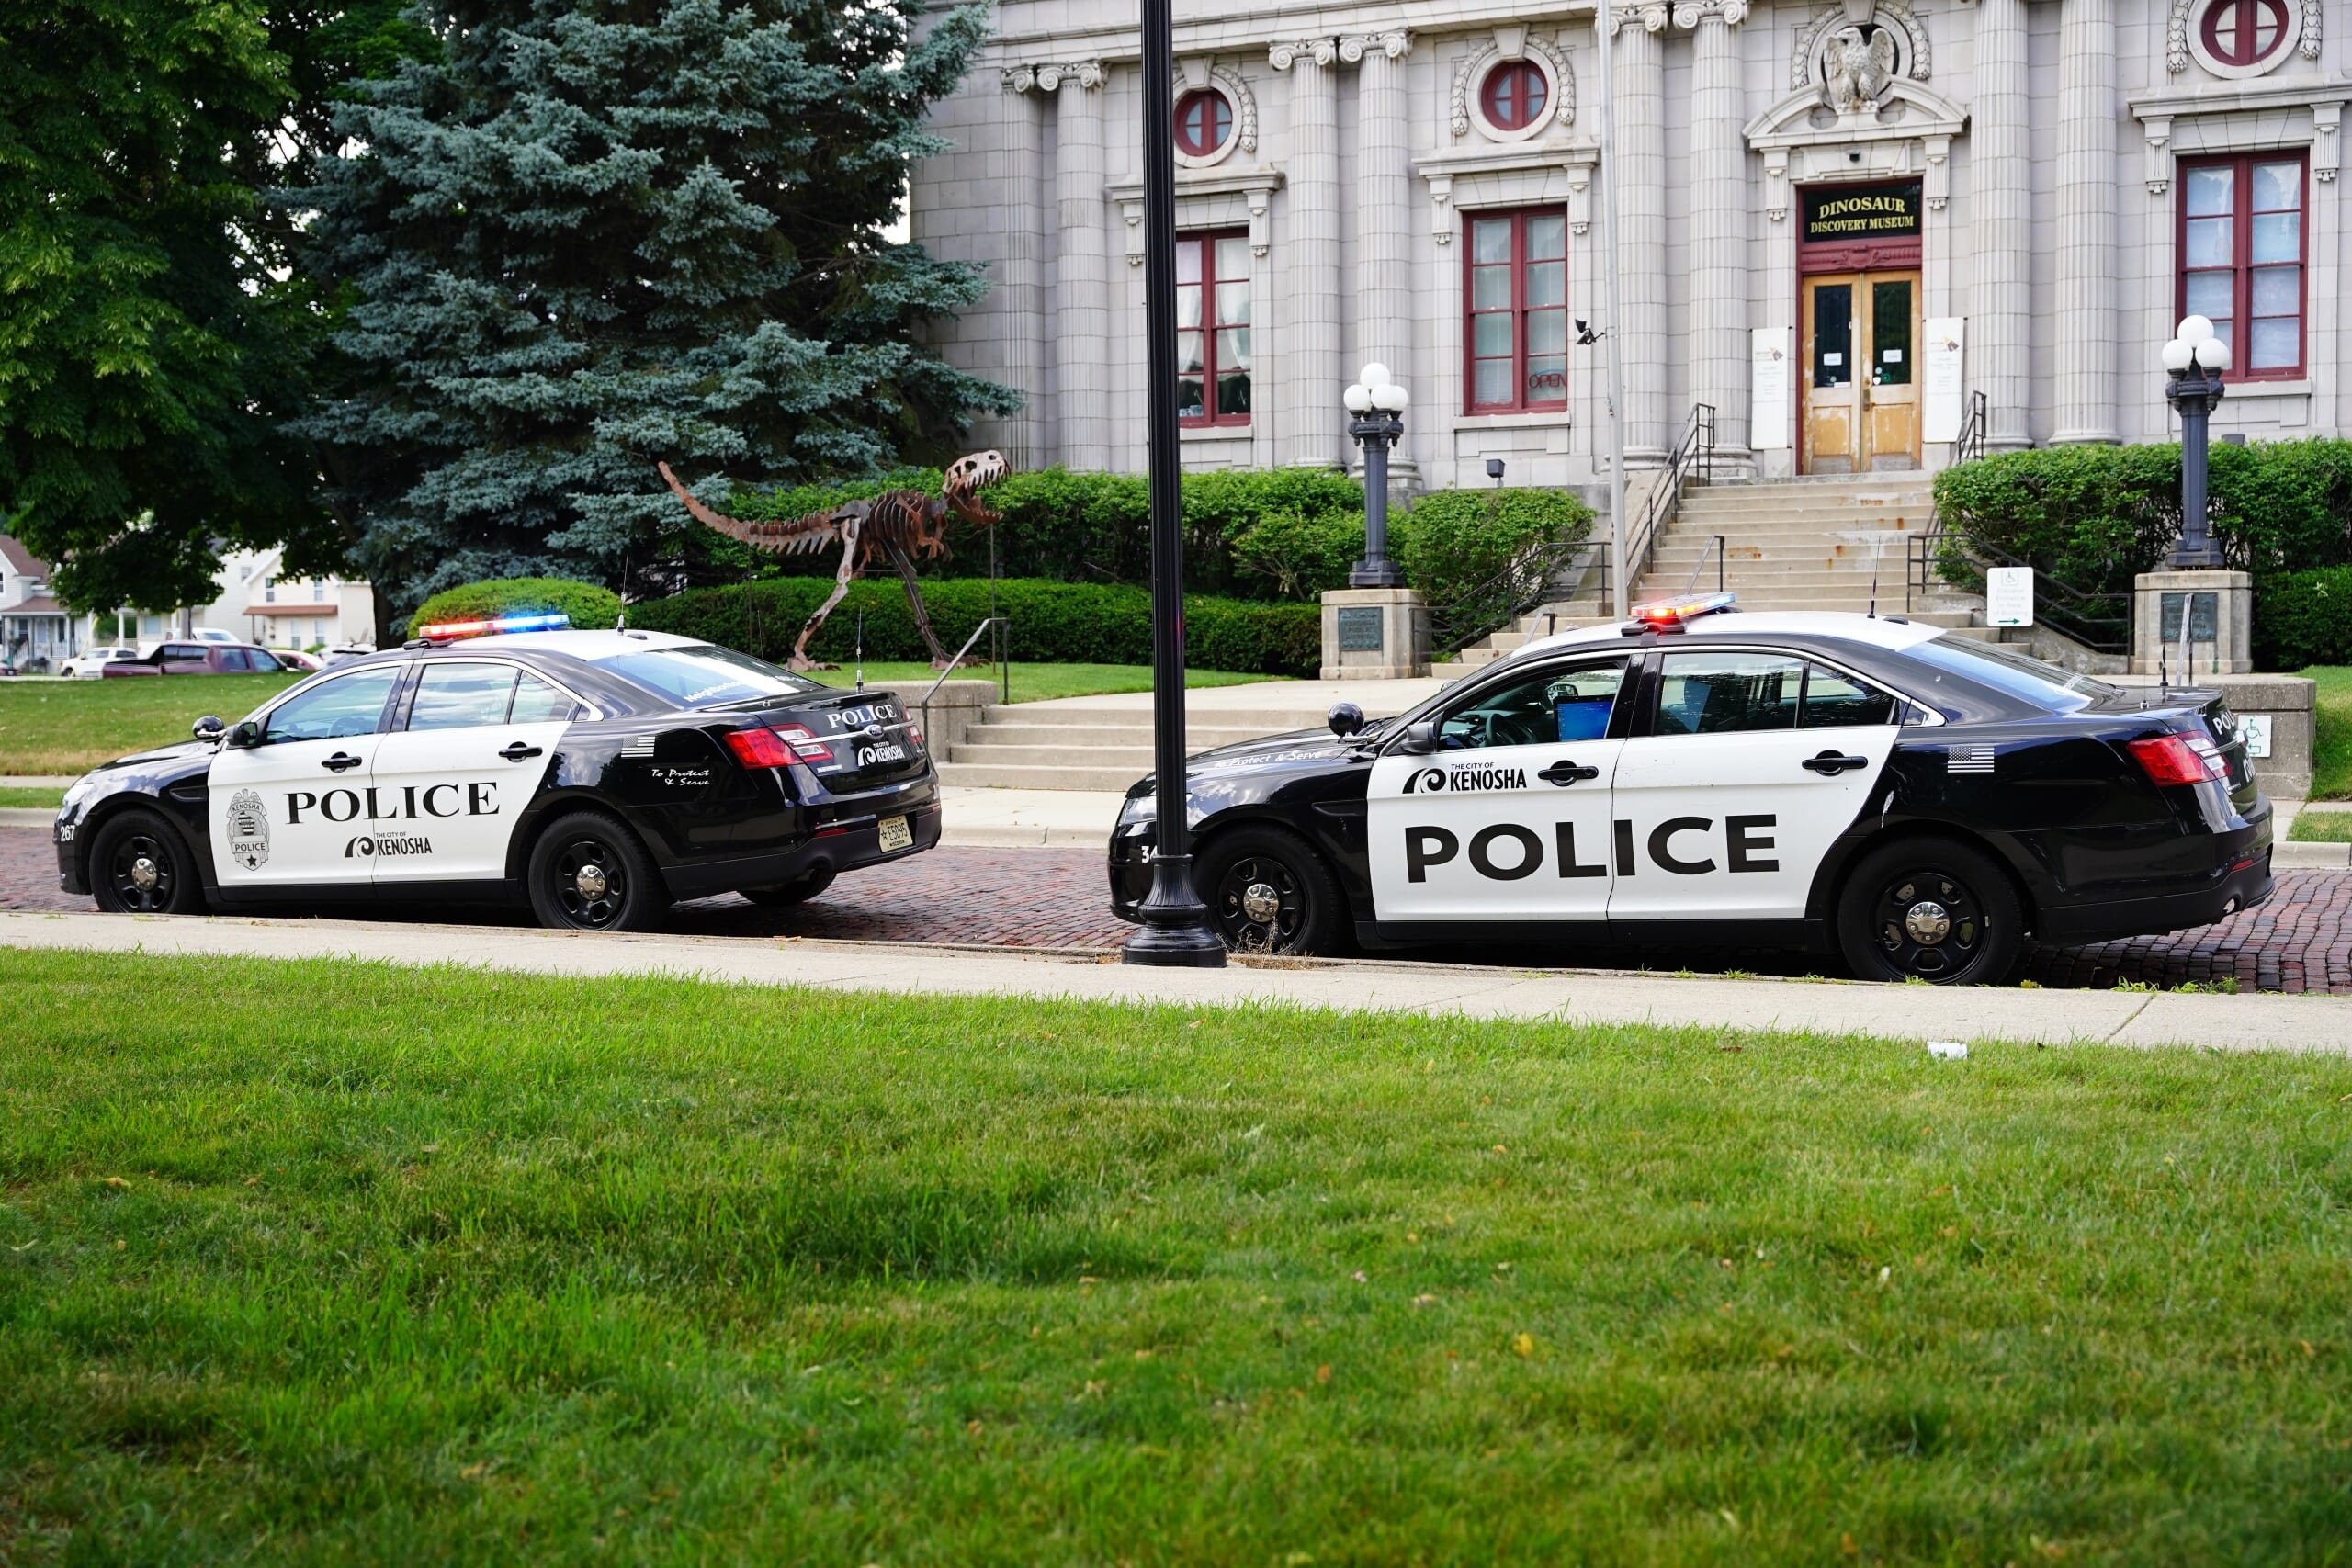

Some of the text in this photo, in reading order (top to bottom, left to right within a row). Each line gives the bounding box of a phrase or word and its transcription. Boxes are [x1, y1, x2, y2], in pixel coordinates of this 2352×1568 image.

[1819, 197, 1905, 219] DINOSAUR
[1810, 215, 1914, 233] DISCOVERY MUSEUM
[1528, 373, 1567, 389] OPEN
[826, 705, 898, 728] POLICE
[875, 744, 905, 762] KENOSHA
[1231, 755, 1271, 765] Protect
[1275, 753, 1284, 762] &
[1288, 750, 1322, 761] Serve
[651, 768, 709, 777] To Protect
[664, 777, 709, 786] & Serve
[1450, 768, 1527, 792] KENOSHA
[232, 802, 260, 812] KENOSHA
[286, 782, 501, 825] POLICE
[60, 825, 76, 842] 267
[234, 842, 266, 852] POLICE
[377, 837, 433, 856] KENOSHA
[1405, 814, 1780, 884] POLICE
